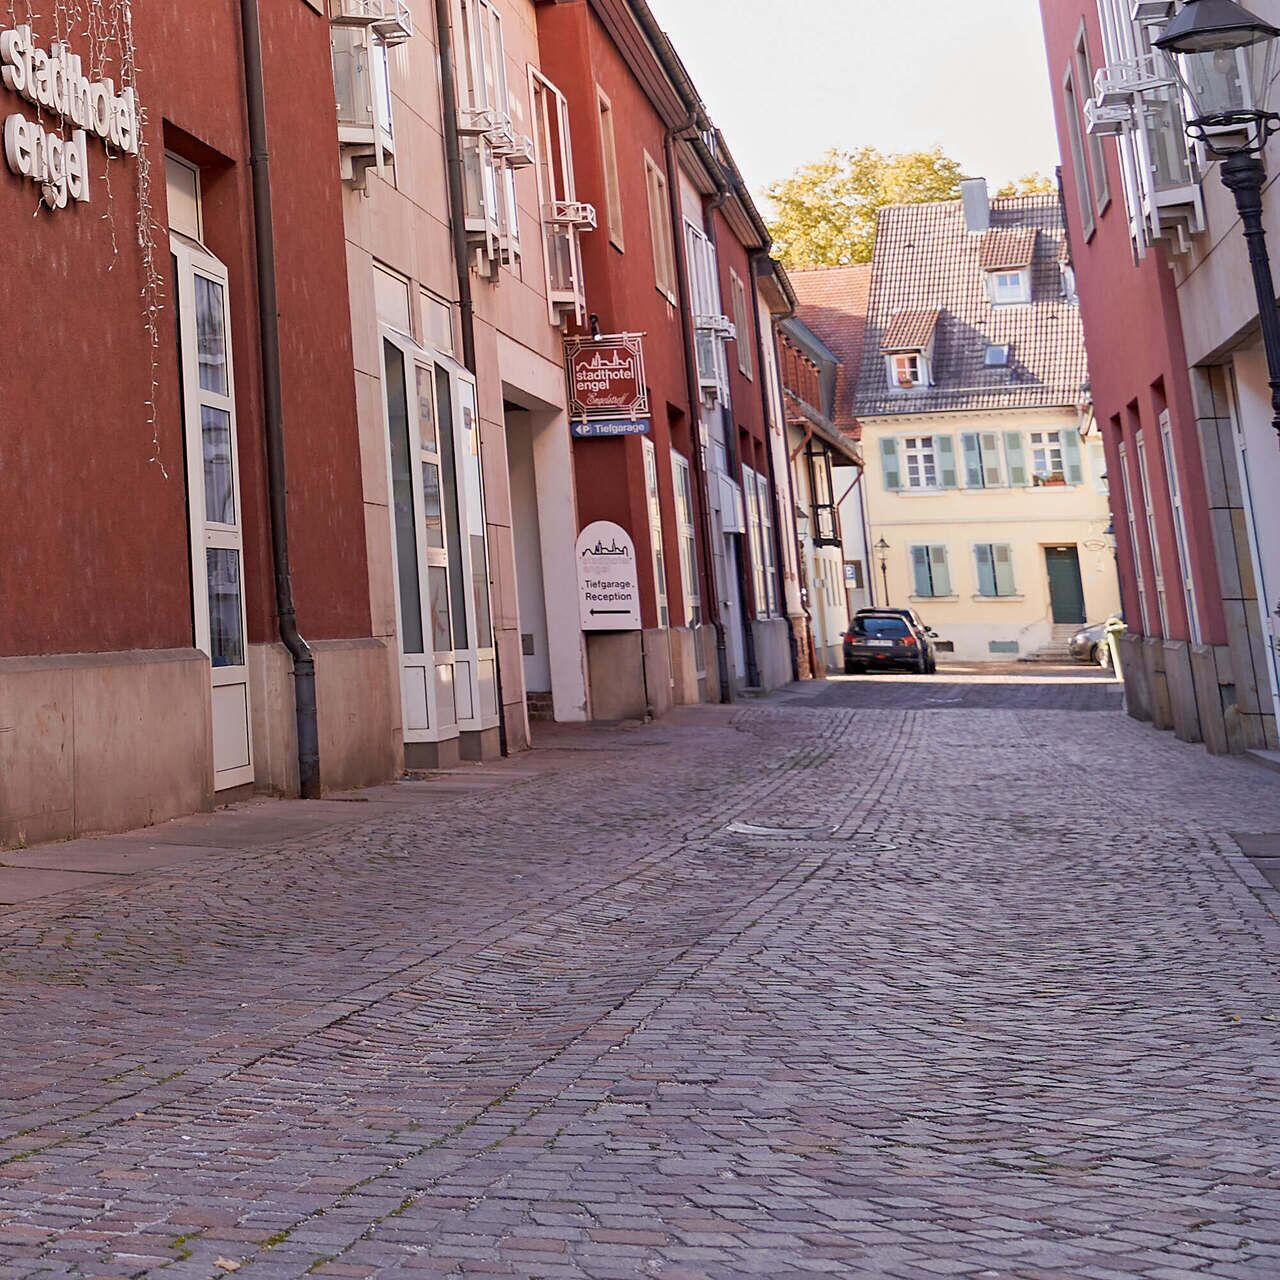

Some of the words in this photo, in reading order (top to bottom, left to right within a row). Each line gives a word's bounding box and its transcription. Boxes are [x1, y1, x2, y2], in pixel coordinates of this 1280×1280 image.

[0, 24, 139, 155] stadthotel
[4, 113, 90, 210] engel
[576, 369, 635, 381] stadthotel
[576, 380, 609, 392] engel
[594, 423, 645, 434] Tiefgarage
[585, 580, 631, 589] Tiefgarage
[585, 592, 632, 602] Reception
